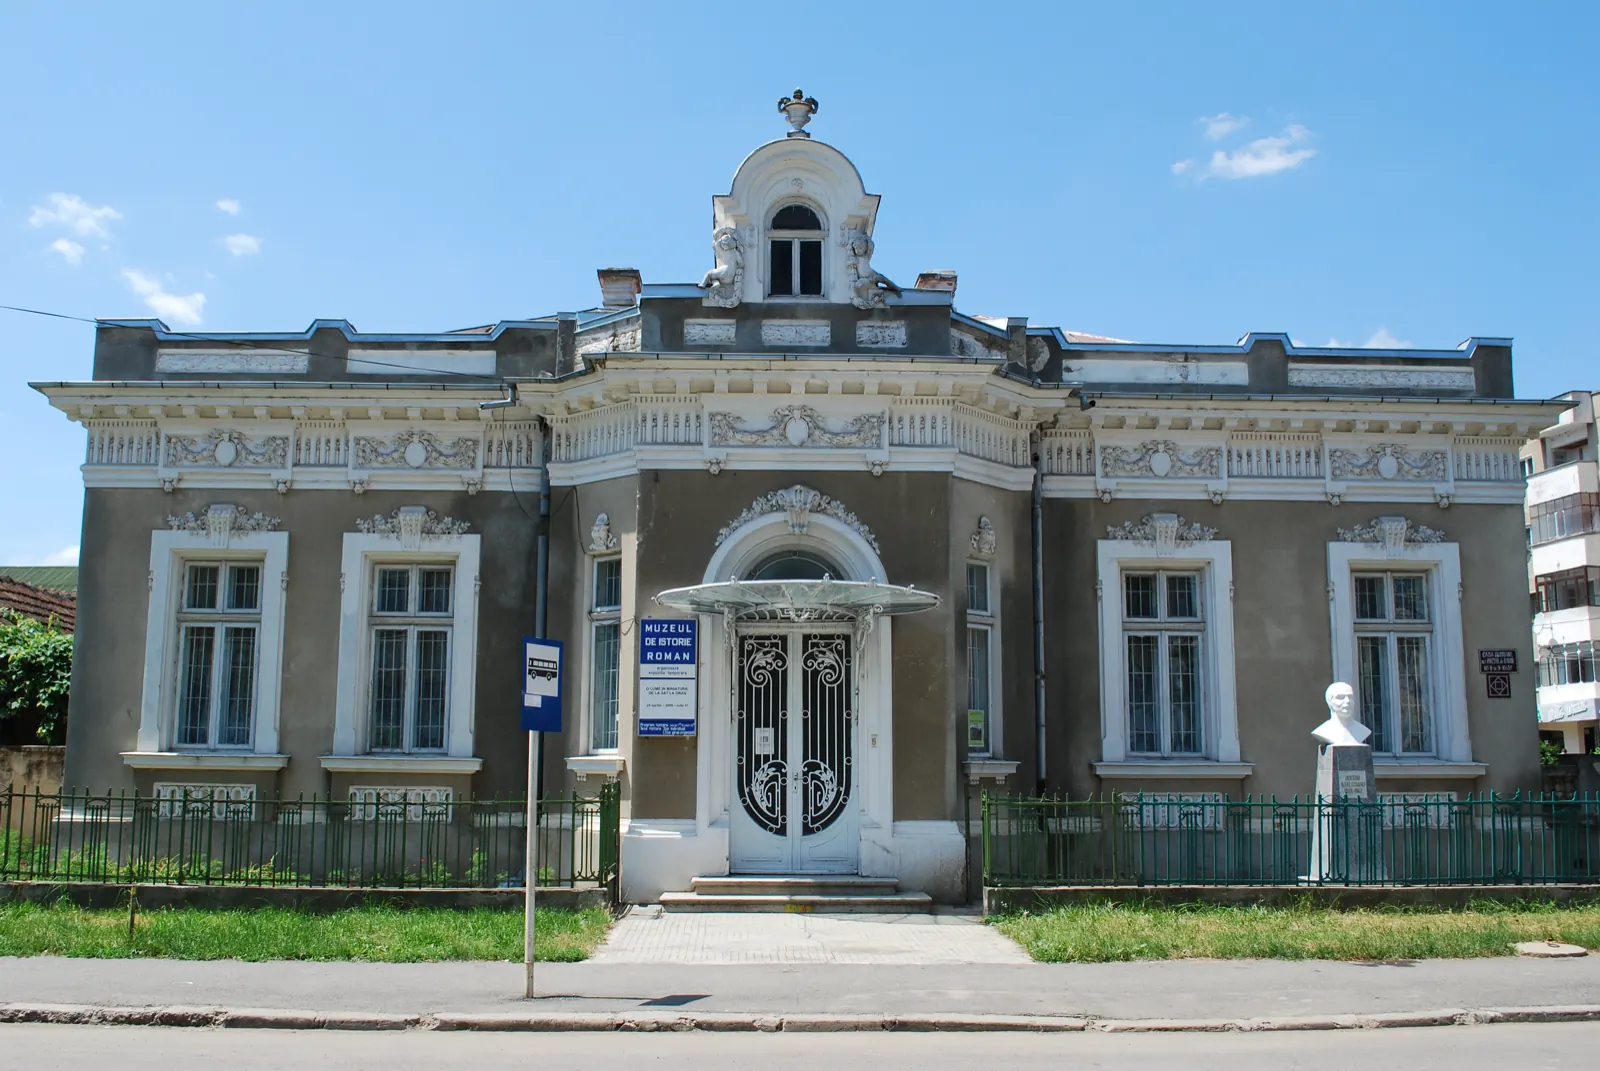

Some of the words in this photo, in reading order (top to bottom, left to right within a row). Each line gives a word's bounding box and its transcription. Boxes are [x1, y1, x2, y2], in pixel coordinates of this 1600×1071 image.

[645, 623, 692, 633] MUZEUL
[645, 637, 657, 647] DE
[658, 637, 692, 647] ISTORIE
[646, 651, 690, 661] ROMAN
